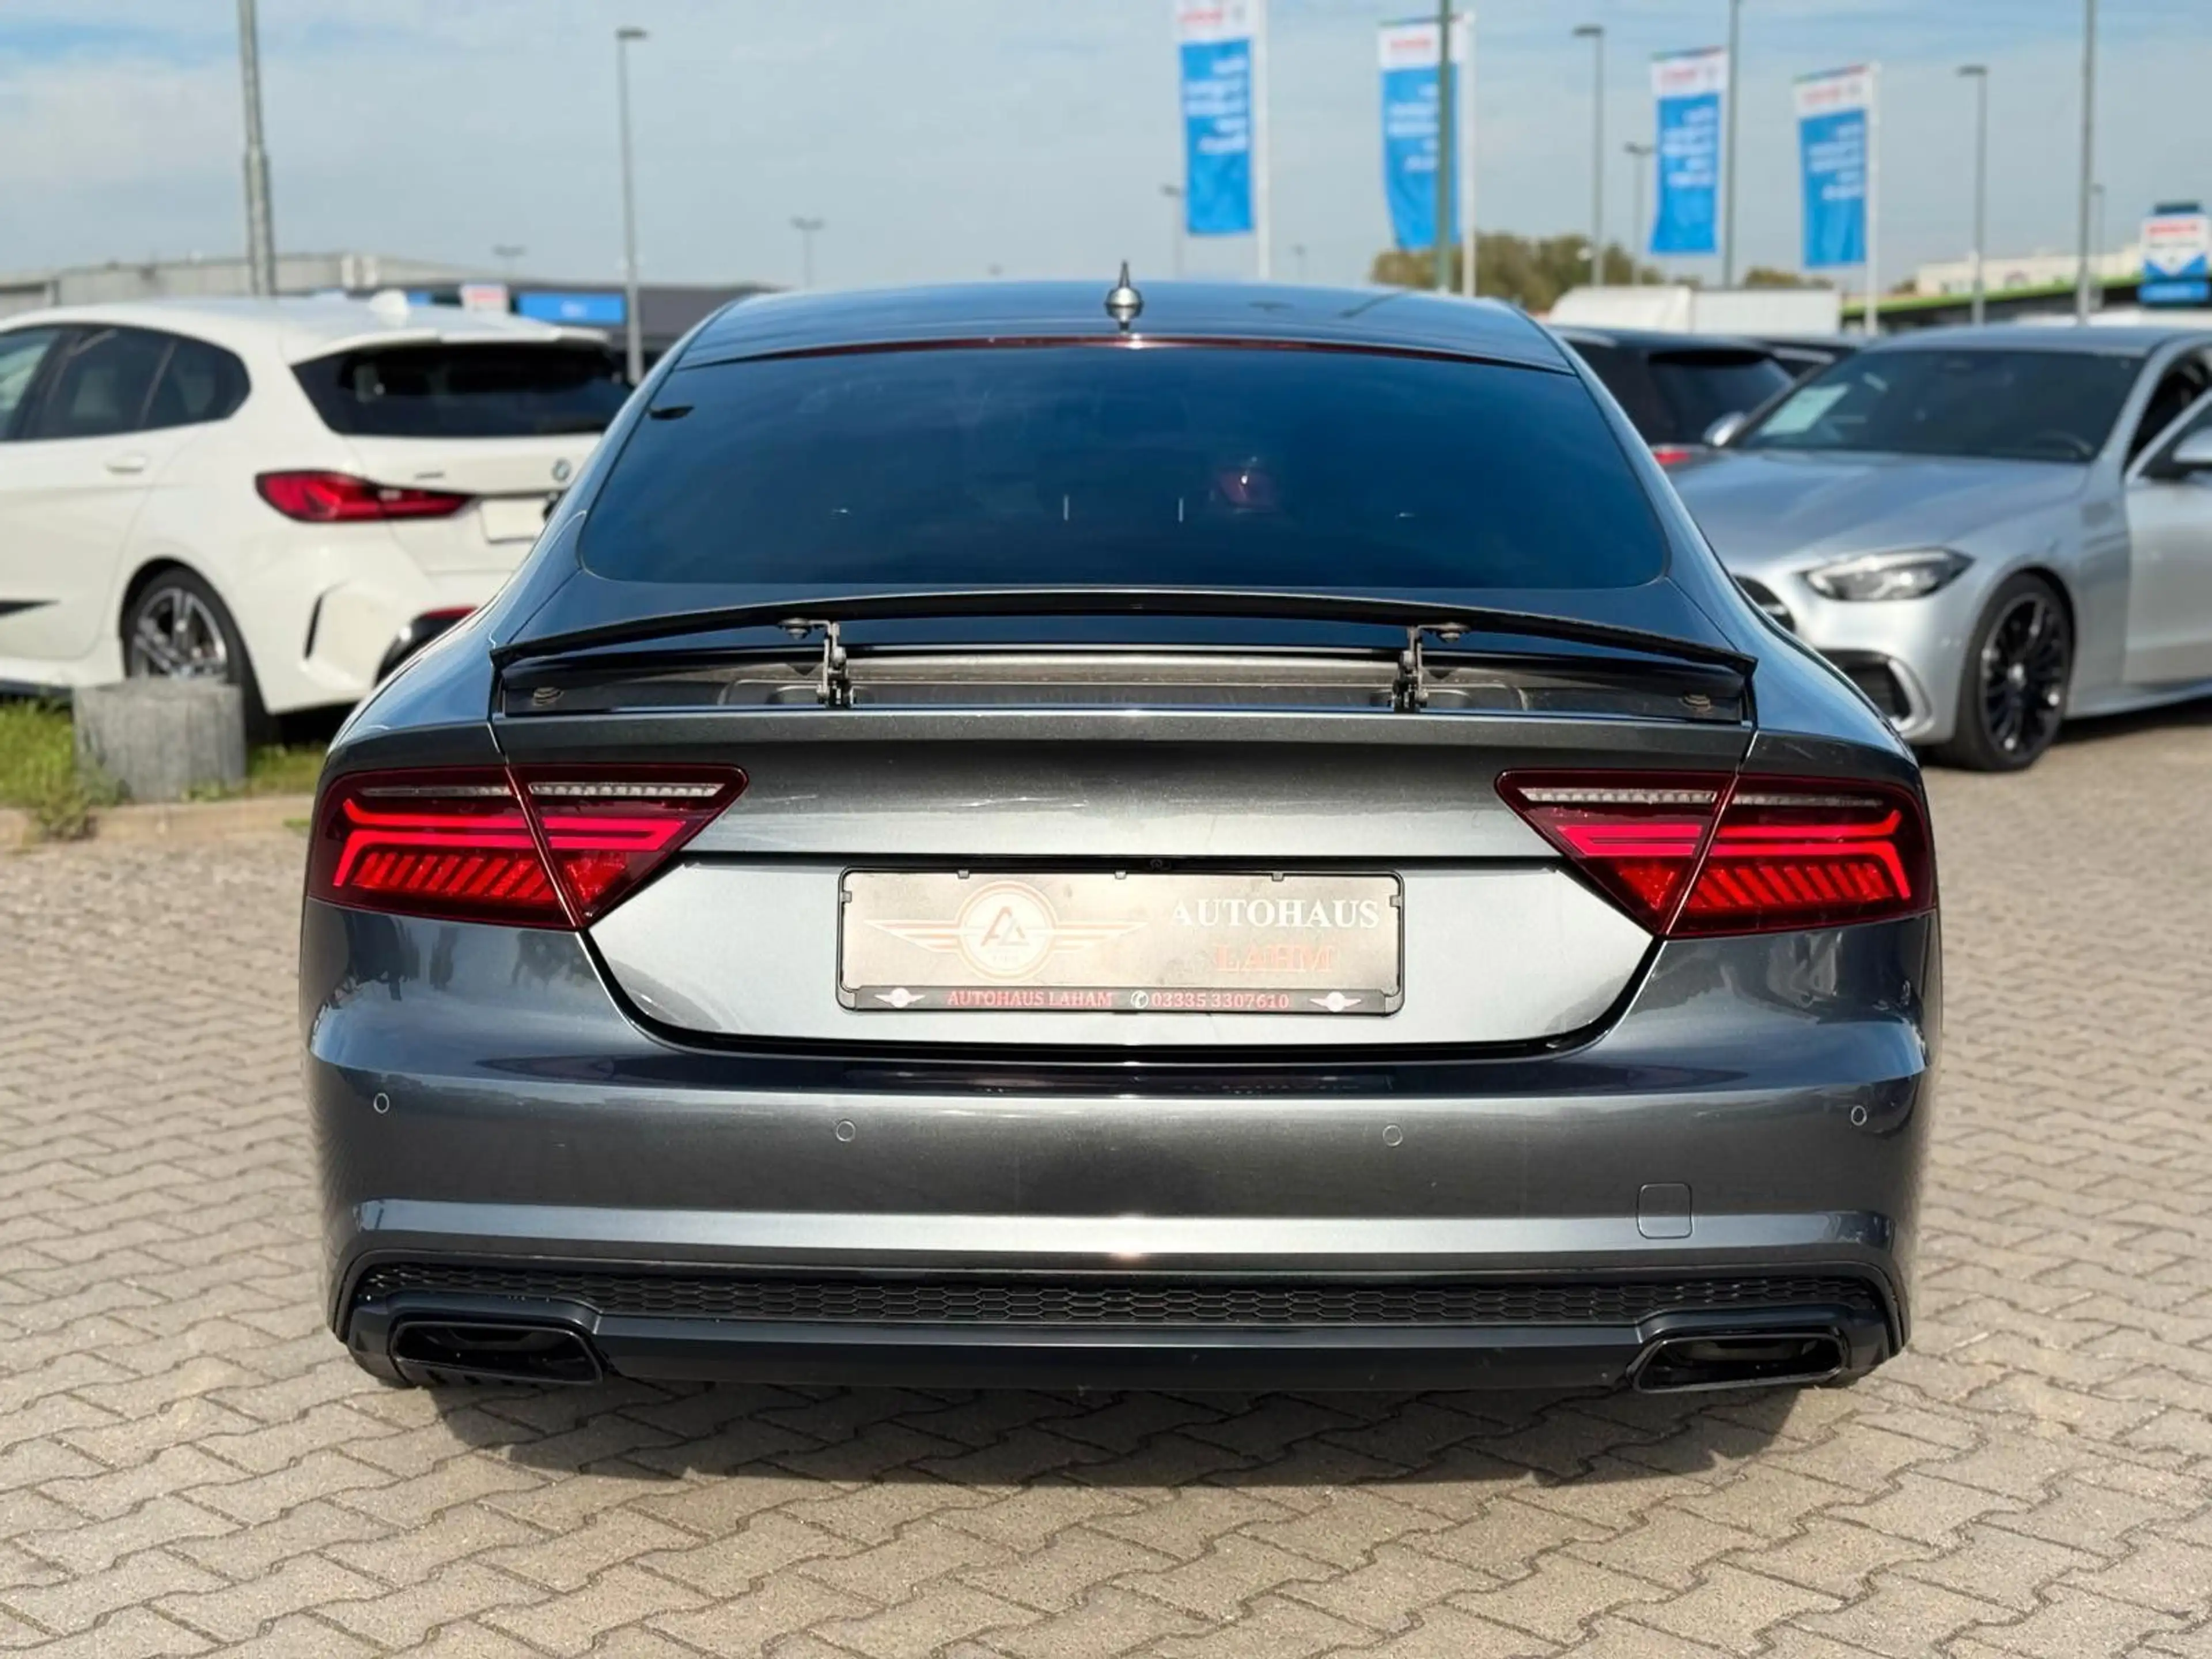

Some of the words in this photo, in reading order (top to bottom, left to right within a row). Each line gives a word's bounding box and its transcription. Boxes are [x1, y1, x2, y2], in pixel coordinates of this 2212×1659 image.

[1172, 897, 1380, 929] AUTOHAUS
[948, 990, 1044, 1006] AUTOHAUS
[1048, 991, 1112, 1007] LAHAM
[1151, 992, 1207, 1007] 03335
[1211, 993, 1289, 1009] 3307610
